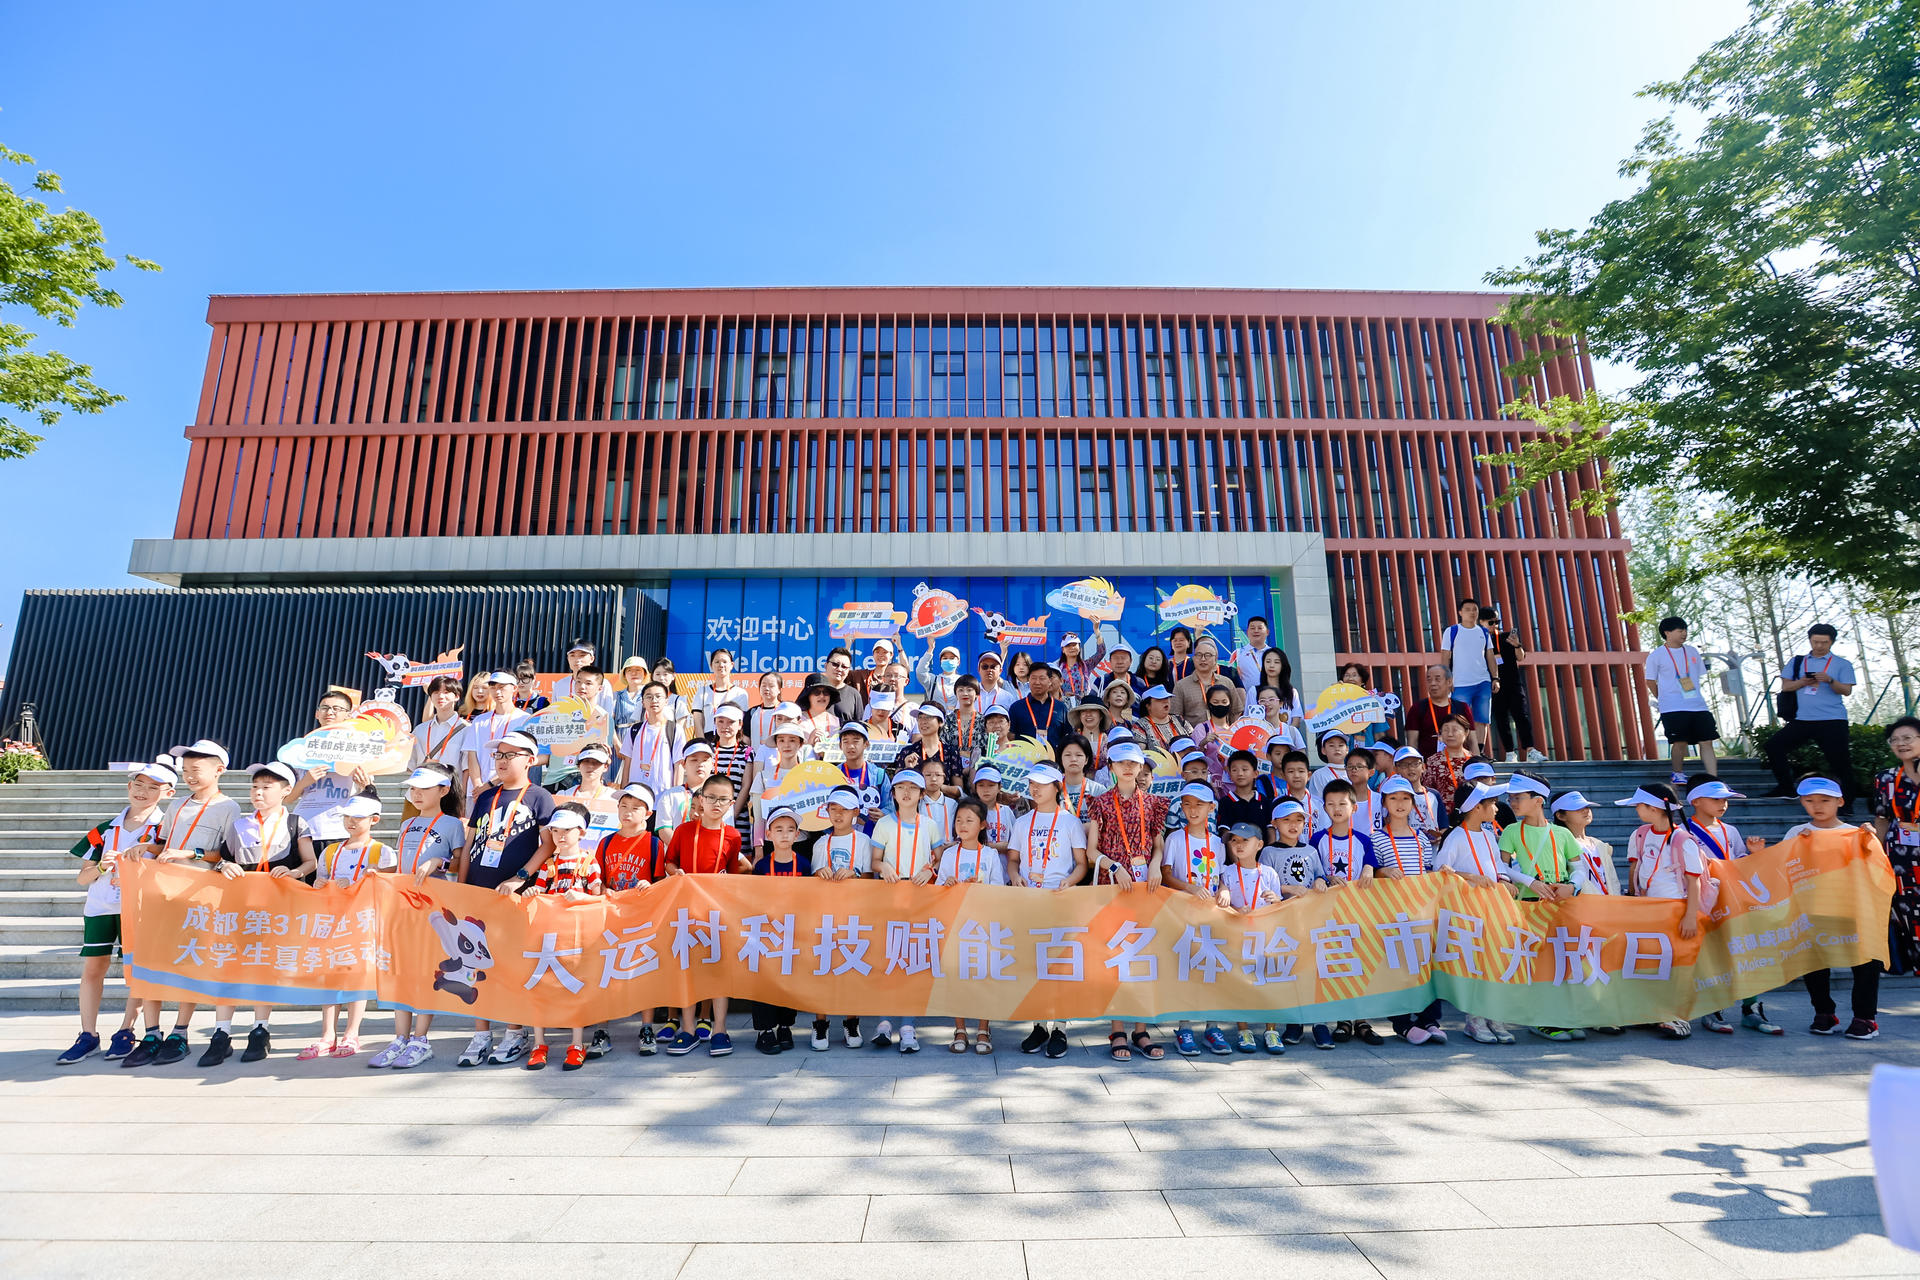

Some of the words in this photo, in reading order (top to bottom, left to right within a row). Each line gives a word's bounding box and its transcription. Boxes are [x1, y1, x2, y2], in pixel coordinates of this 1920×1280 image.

[707, 616, 815, 642] 欢迎中心
[526, 723, 585, 736] 成都成就梦想
[305, 749, 344, 760] Chengdu
[307, 738, 383, 756] 成都成就梦想
[510, 819, 537, 836] CLUB
[182, 906, 376, 937] 成都第31届世界
[173, 937, 392, 972] 大学生夏季运动会
[523, 907, 1672, 993] 大运村科技赋能百名体验官市民开放日
